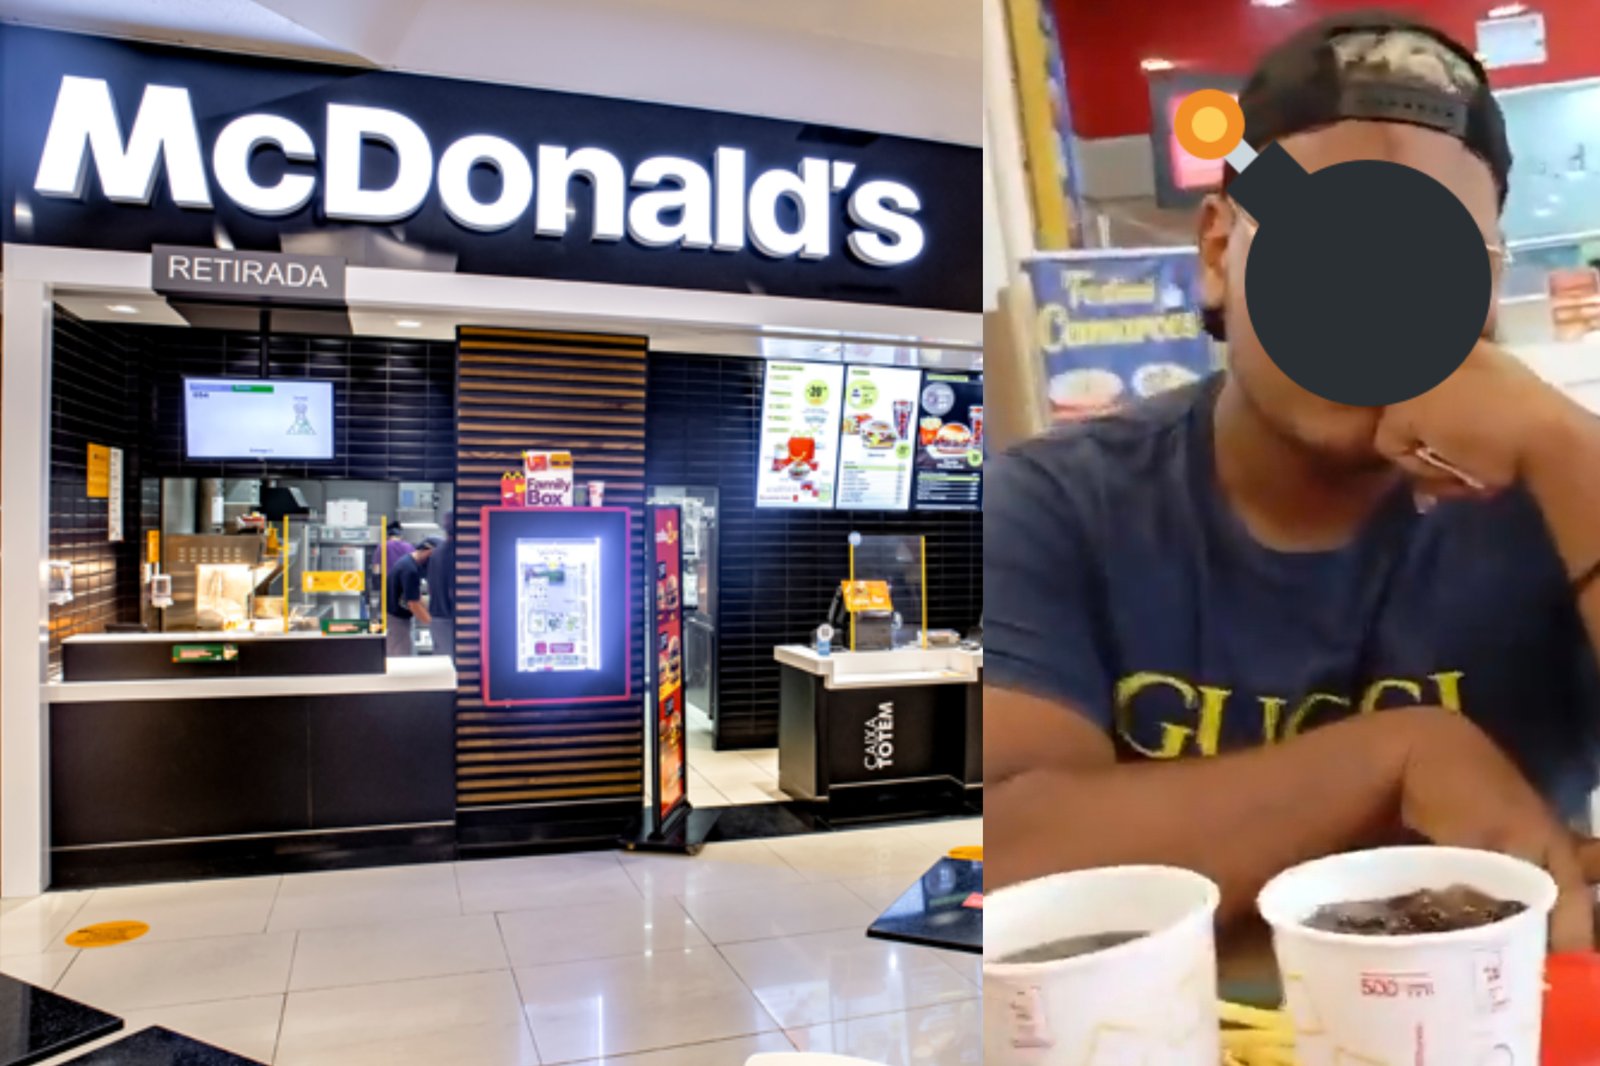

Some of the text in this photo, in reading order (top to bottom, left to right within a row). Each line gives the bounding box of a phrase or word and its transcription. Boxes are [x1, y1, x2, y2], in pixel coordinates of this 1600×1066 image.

[35, 75, 926, 267] McDonald's
[168, 254, 329, 288] RETIRADA
[526, 478, 571, 493] Family
[526, 489, 564, 506] Box
[864, 716, 879, 771] CAIXA
[878, 701, 894, 770] TOTEM
[1360, 978, 1399, 997] 500
